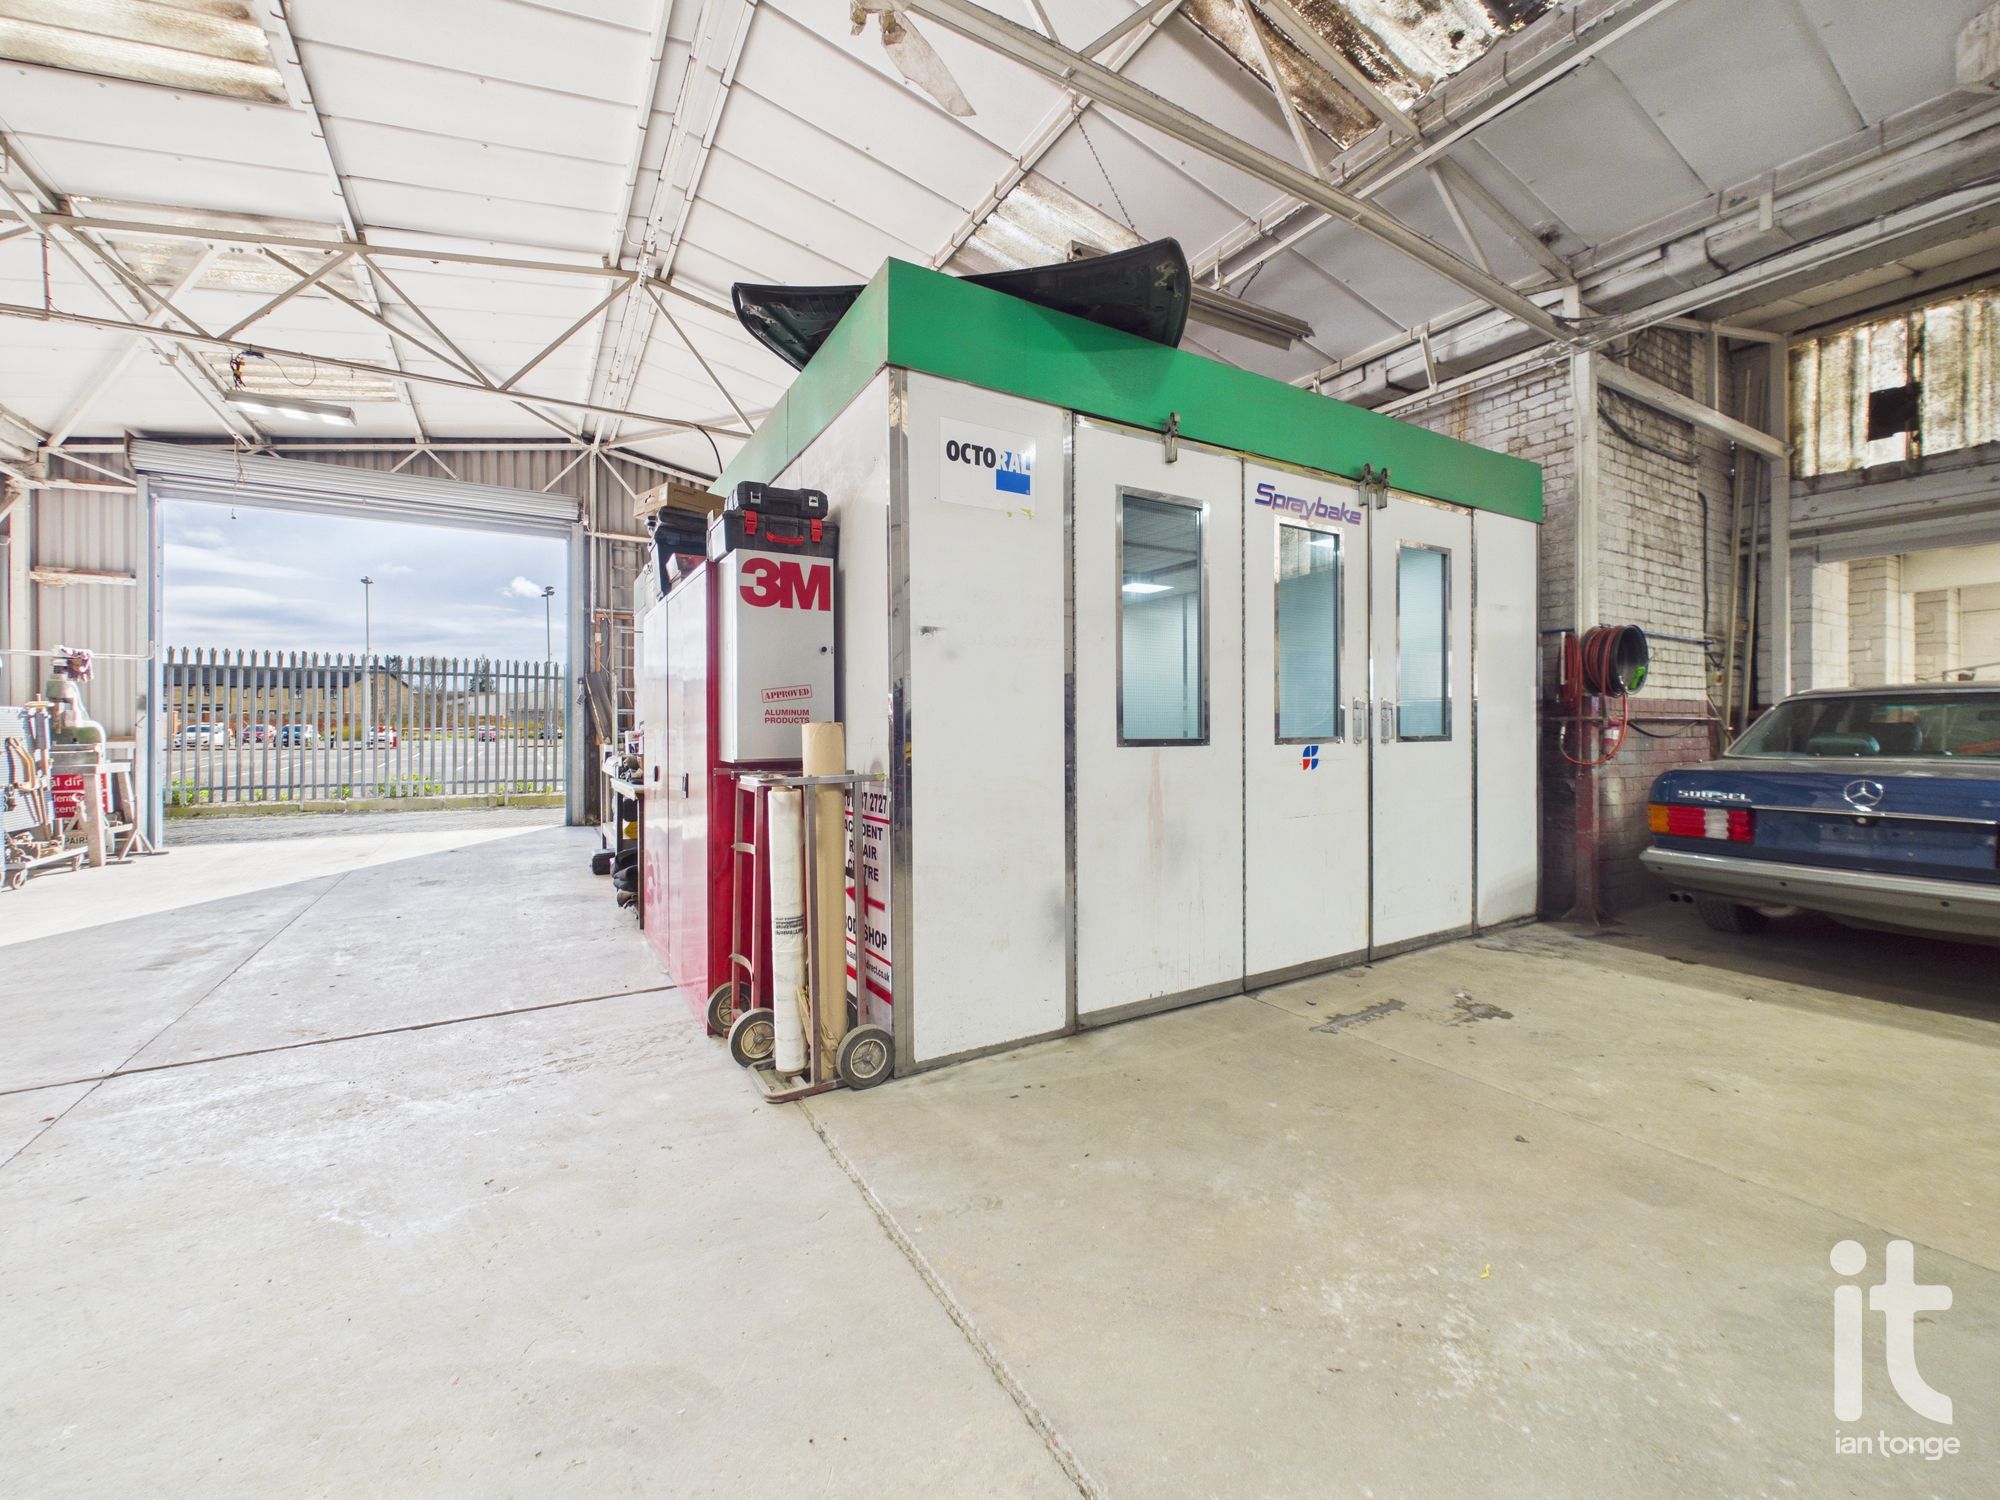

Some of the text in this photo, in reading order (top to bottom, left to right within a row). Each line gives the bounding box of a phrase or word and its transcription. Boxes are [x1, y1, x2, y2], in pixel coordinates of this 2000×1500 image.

[1255, 483, 1361, 525] Spraybake
[739, 558, 831, 611] 3M
[765, 688, 810, 701] APPROVED
[764, 709, 810, 717] ALUMINUM
[764, 717, 810, 725] PRODUCTS
[870, 793, 887, 814] 2727
[845, 819, 883, 840] ACDENT
[849, 840, 877, 860] RAIR
[848, 859, 879, 881] CTRE
